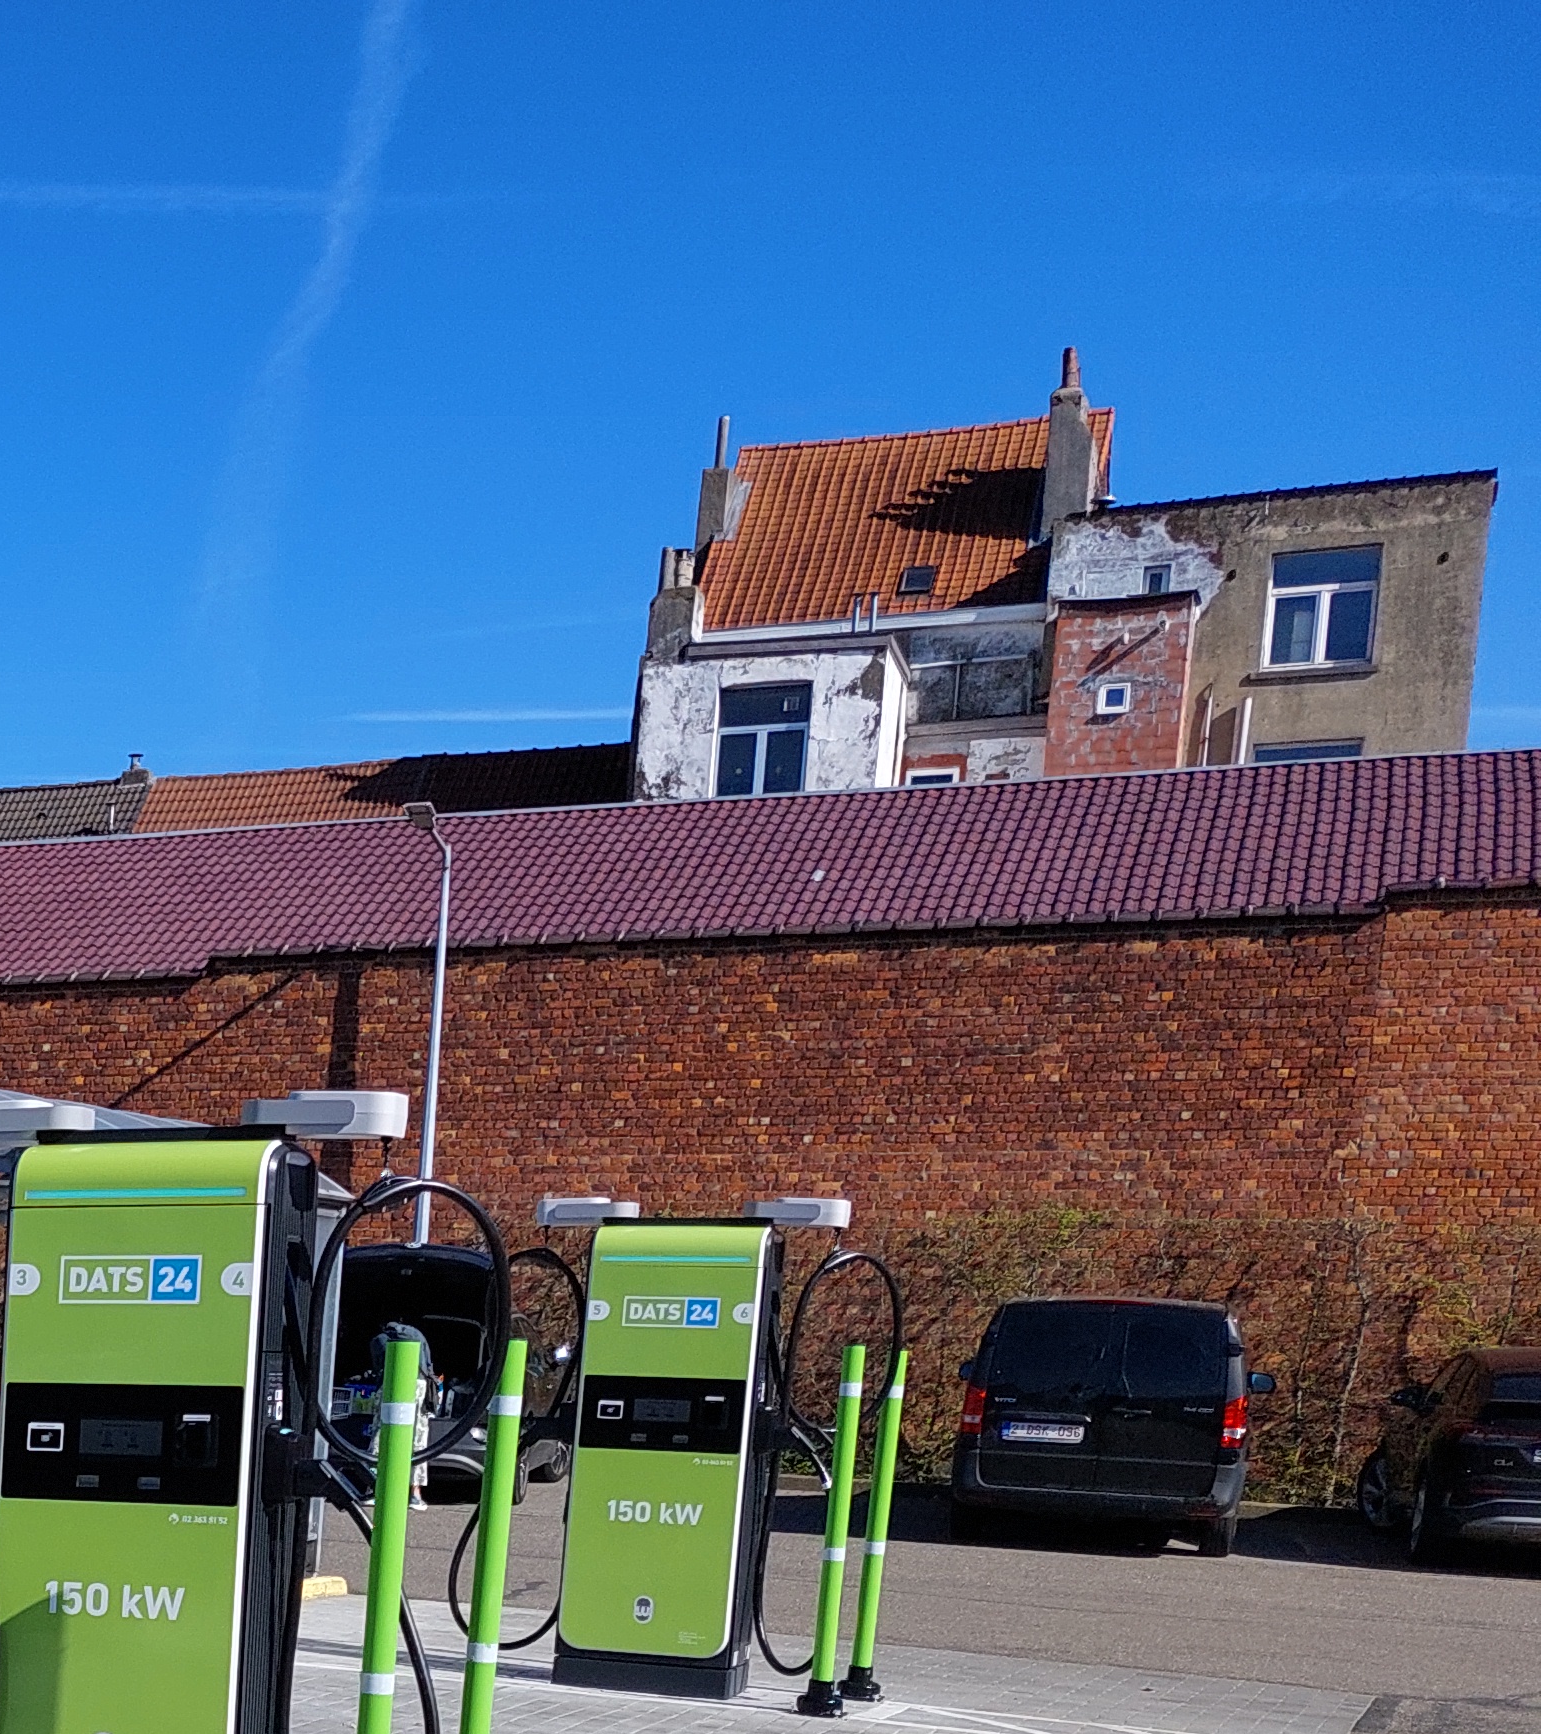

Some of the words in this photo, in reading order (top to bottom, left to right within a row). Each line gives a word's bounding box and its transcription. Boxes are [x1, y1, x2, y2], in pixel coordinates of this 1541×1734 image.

[15, 1269, 28, 1286] 3
[68, 1266, 144, 1293] DATS
[157, 1266, 193, 1293] 24
[232, 1270, 245, 1288] 4
[593, 1304, 601, 1316] 5
[628, 1303, 682, 1321] DATS
[689, 1304, 714, 1322] 24
[740, 1305, 749, 1319] 6
[605, 1499, 652, 1523] 150
[658, 1502, 704, 1526] kW
[45, 1580, 109, 1617] 150
[121, 1584, 186, 1621] kW
